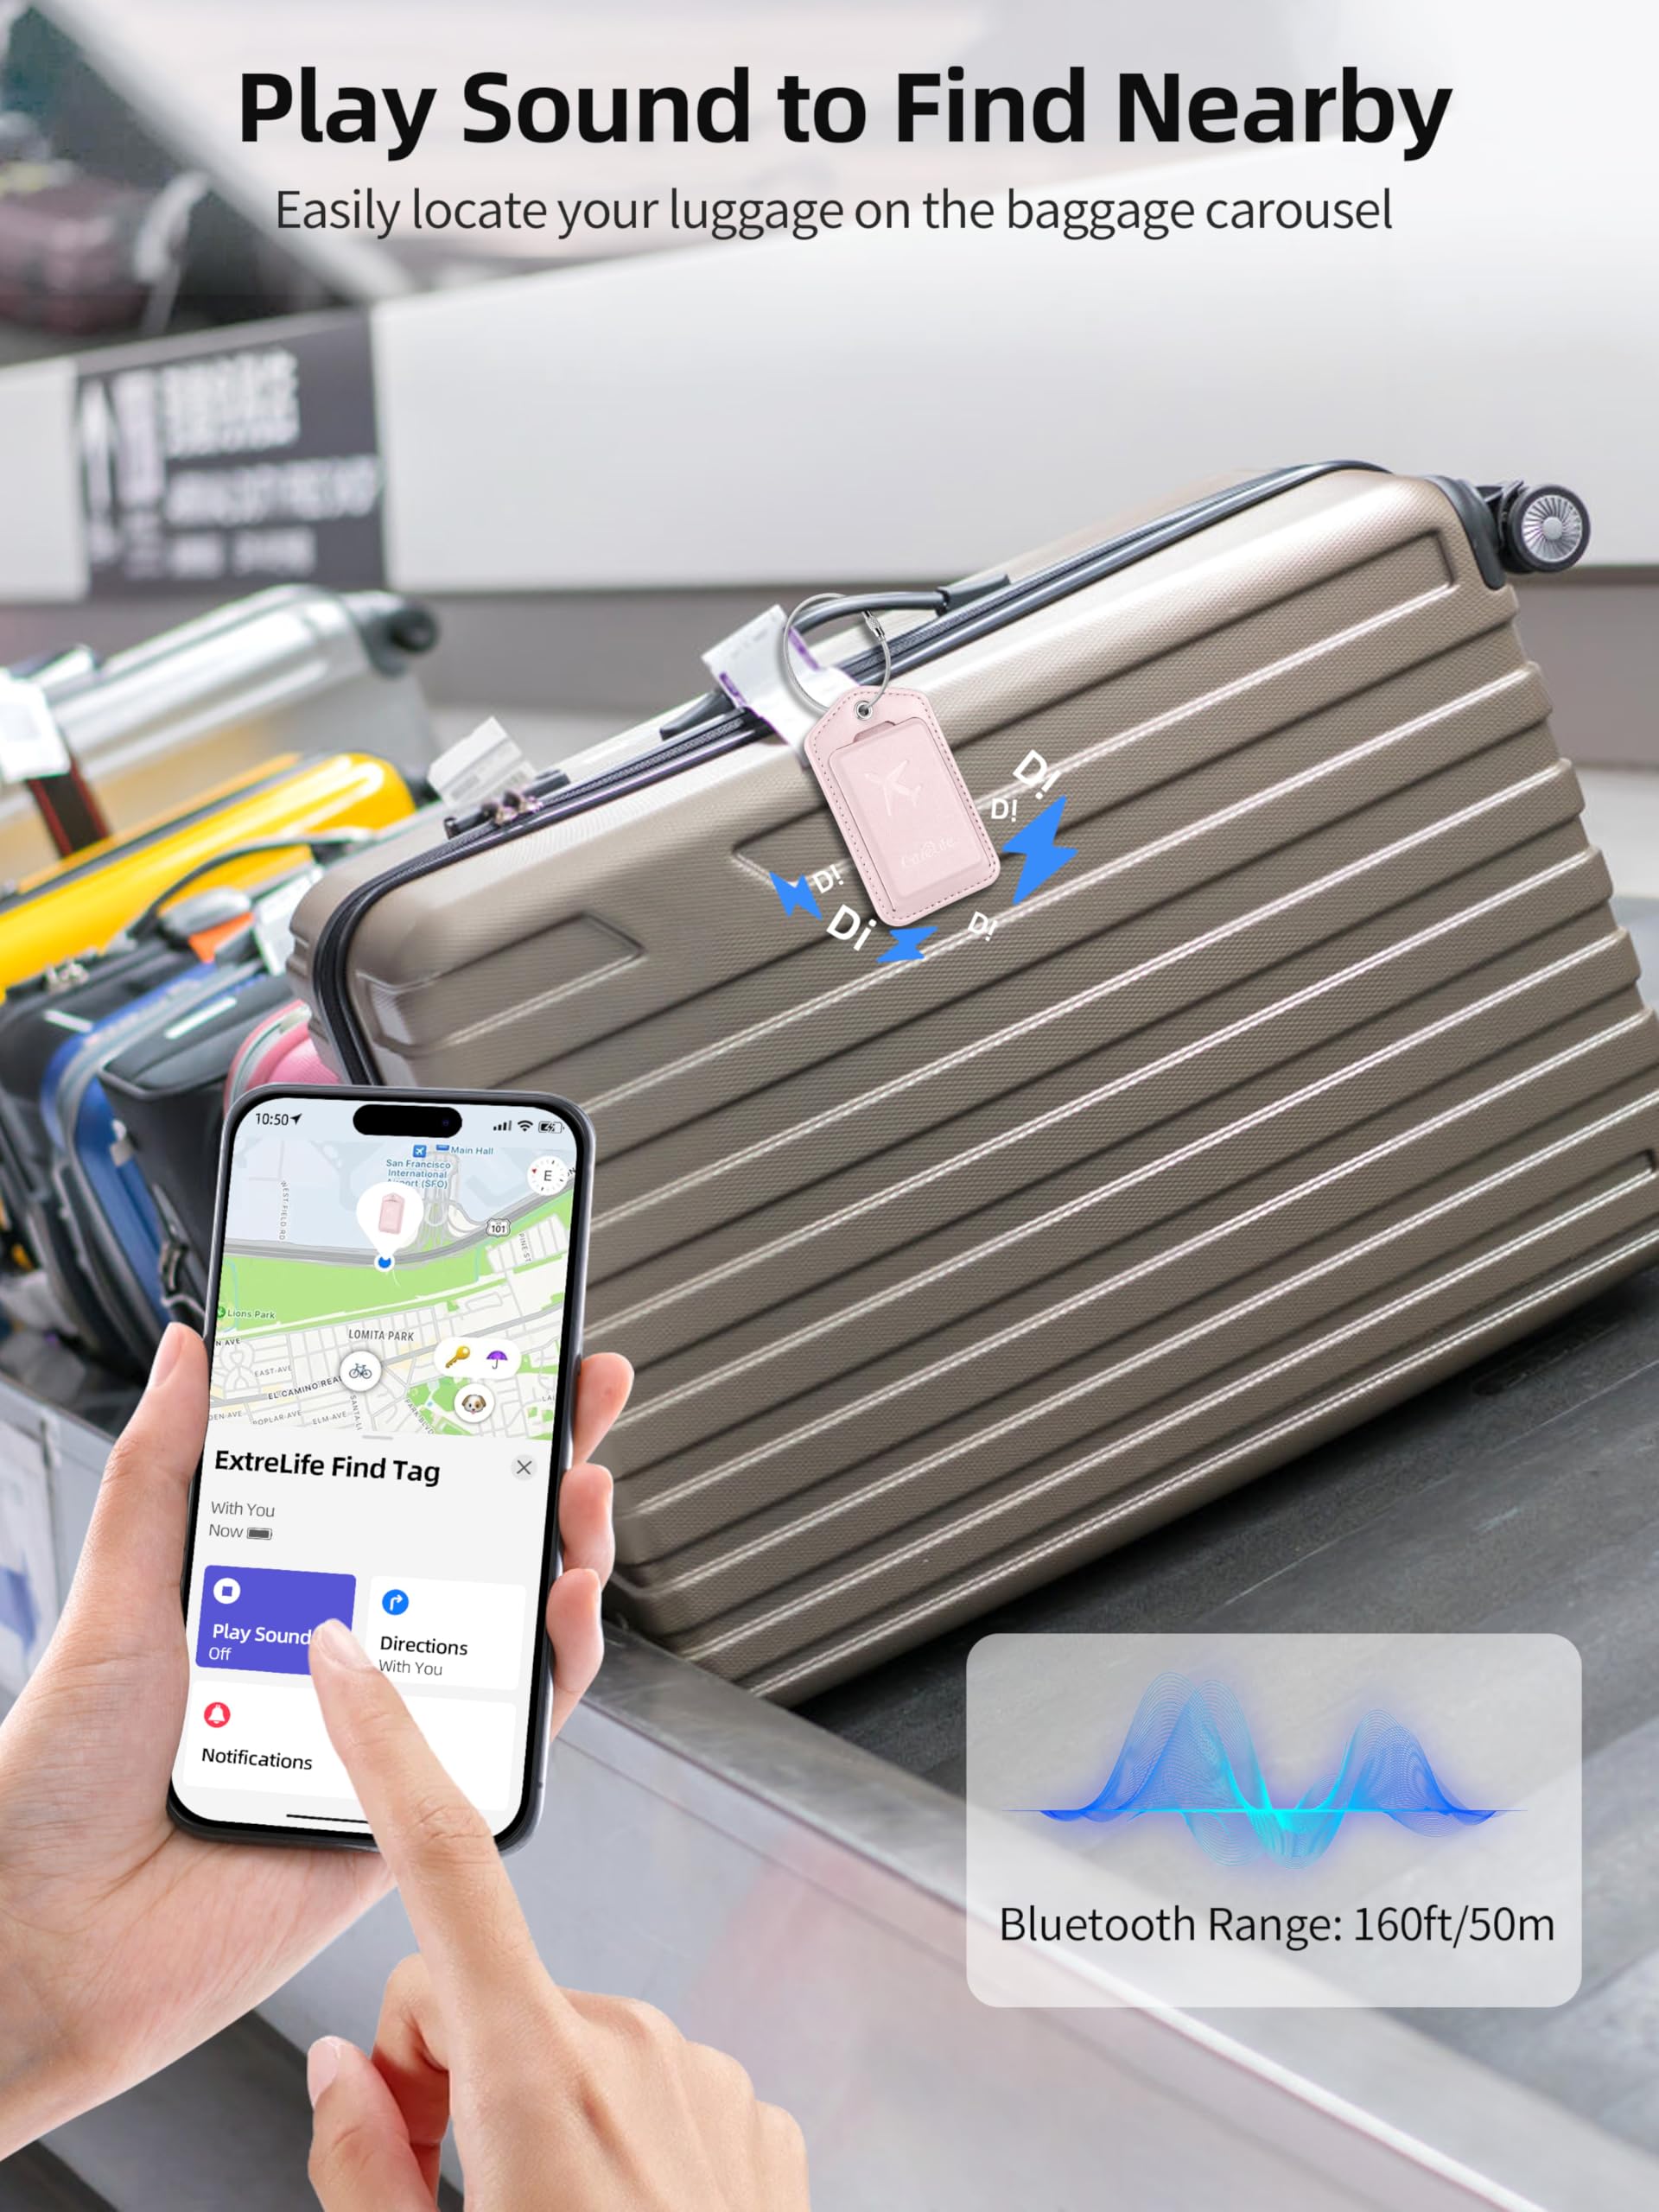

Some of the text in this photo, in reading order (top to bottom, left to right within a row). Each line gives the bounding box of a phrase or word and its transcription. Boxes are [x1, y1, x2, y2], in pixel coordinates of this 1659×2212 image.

[255, 1112, 289, 1126] 10:50
[451, 1146, 494, 1155] Main Hall
[386, 1159, 451, 1169] San Francisco
[388, 1169, 448, 1179] International
[543, 1170, 553, 1181] E
[421, 1179, 448, 1189] (SFO)
[491, 1224, 505, 1234] 101
[519, 1233, 532, 1262] PINE ST
[227, 1309, 276, 1319] Lions Park
[225, 1338, 241, 1346] AVE
[348, 1329, 415, 1342] LOMITA PARK
[281, 1382, 319, 1397] CAMINO
[227, 1410, 243, 1419] AVE
[284, 1410, 302, 1421] AVE
[313, 1411, 347, 1426] ELM AVE
[215, 1450, 441, 1488] ExtreLife Find Tag
[211, 1501, 276, 1517] With You
[208, 1523, 244, 1538] Now
[213, 1623, 312, 1645] Play Sound
[380, 1636, 468, 1656] Directions
[208, 1647, 232, 1661] Off
[378, 1659, 443, 1676] With You
[201, 1747, 313, 1770] Notifications
